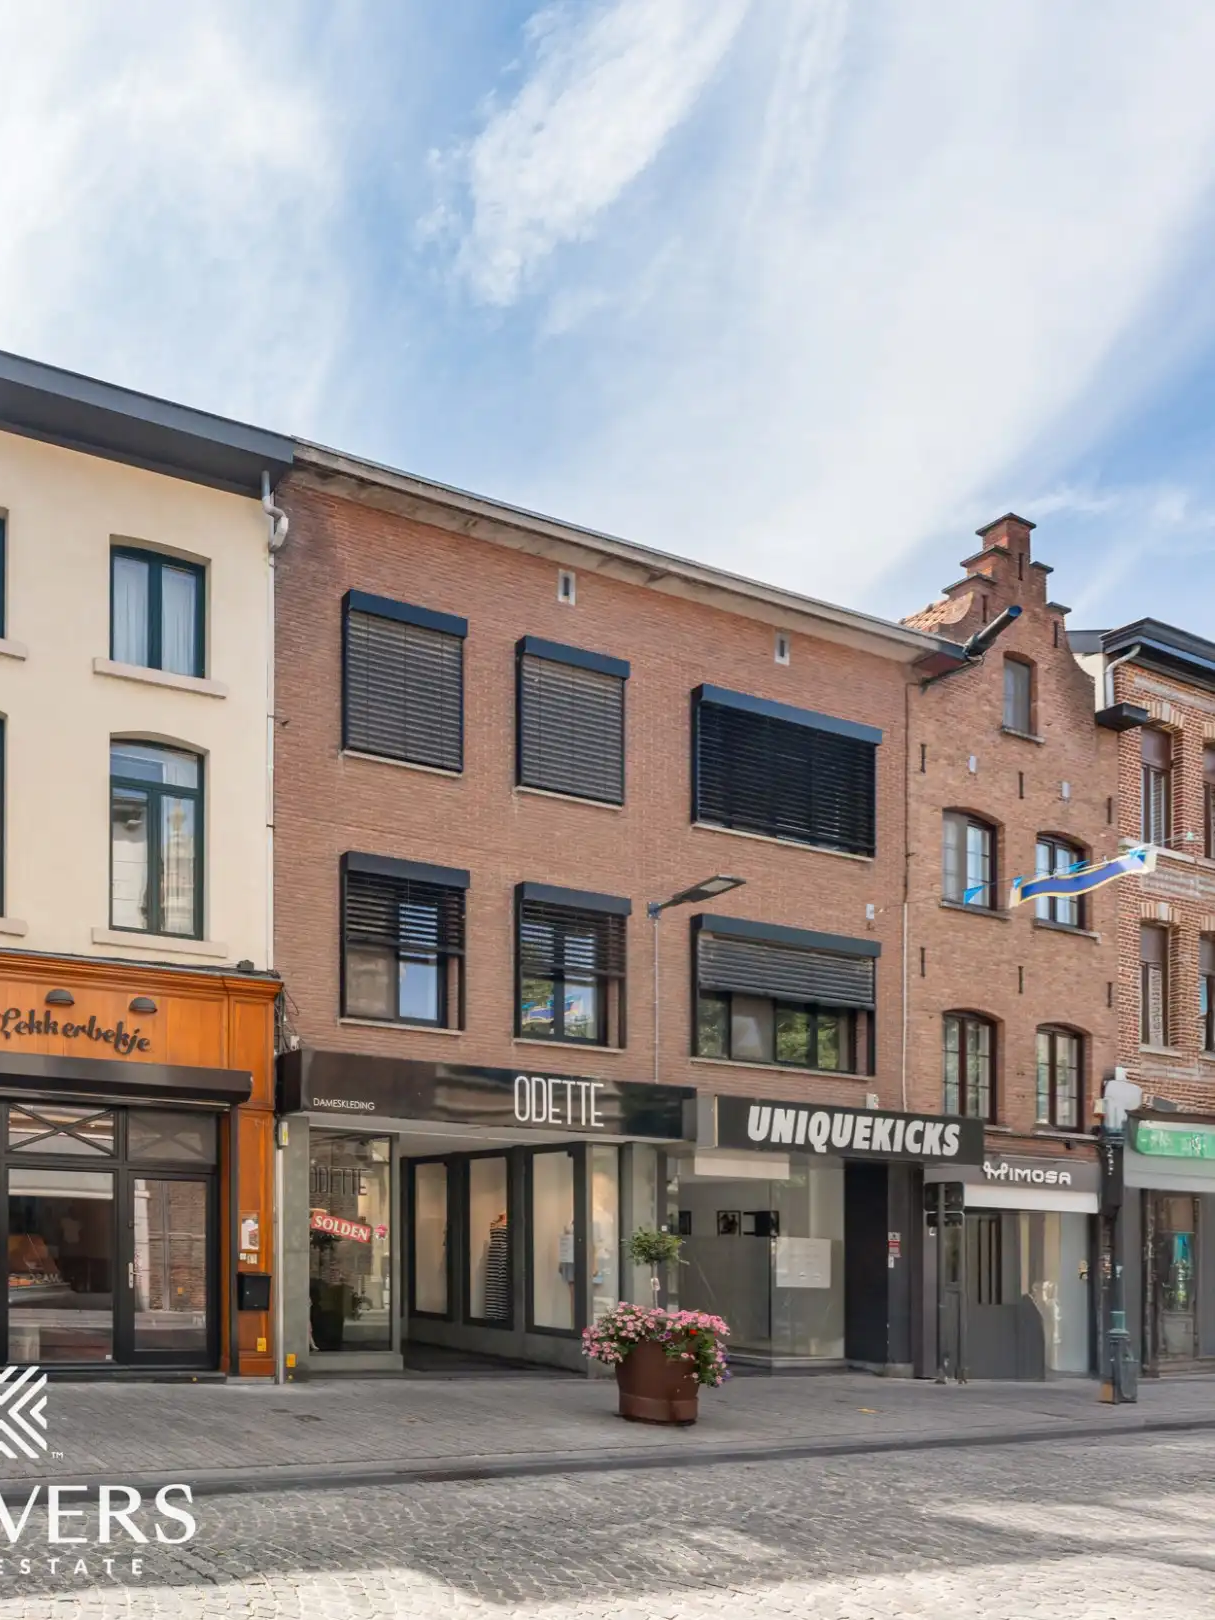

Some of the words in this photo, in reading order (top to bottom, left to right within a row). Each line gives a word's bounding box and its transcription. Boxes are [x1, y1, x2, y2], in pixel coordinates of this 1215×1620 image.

[313, 1097, 375, 1111] DAMESKLEDING
[514, 1075, 604, 1127] ODETTE
[747, 1105, 961, 1157] UNIQUEKICKS
[983, 1161, 1072, 1186] MIMOSA
[314, 1214, 369, 1241] SOLDEN
